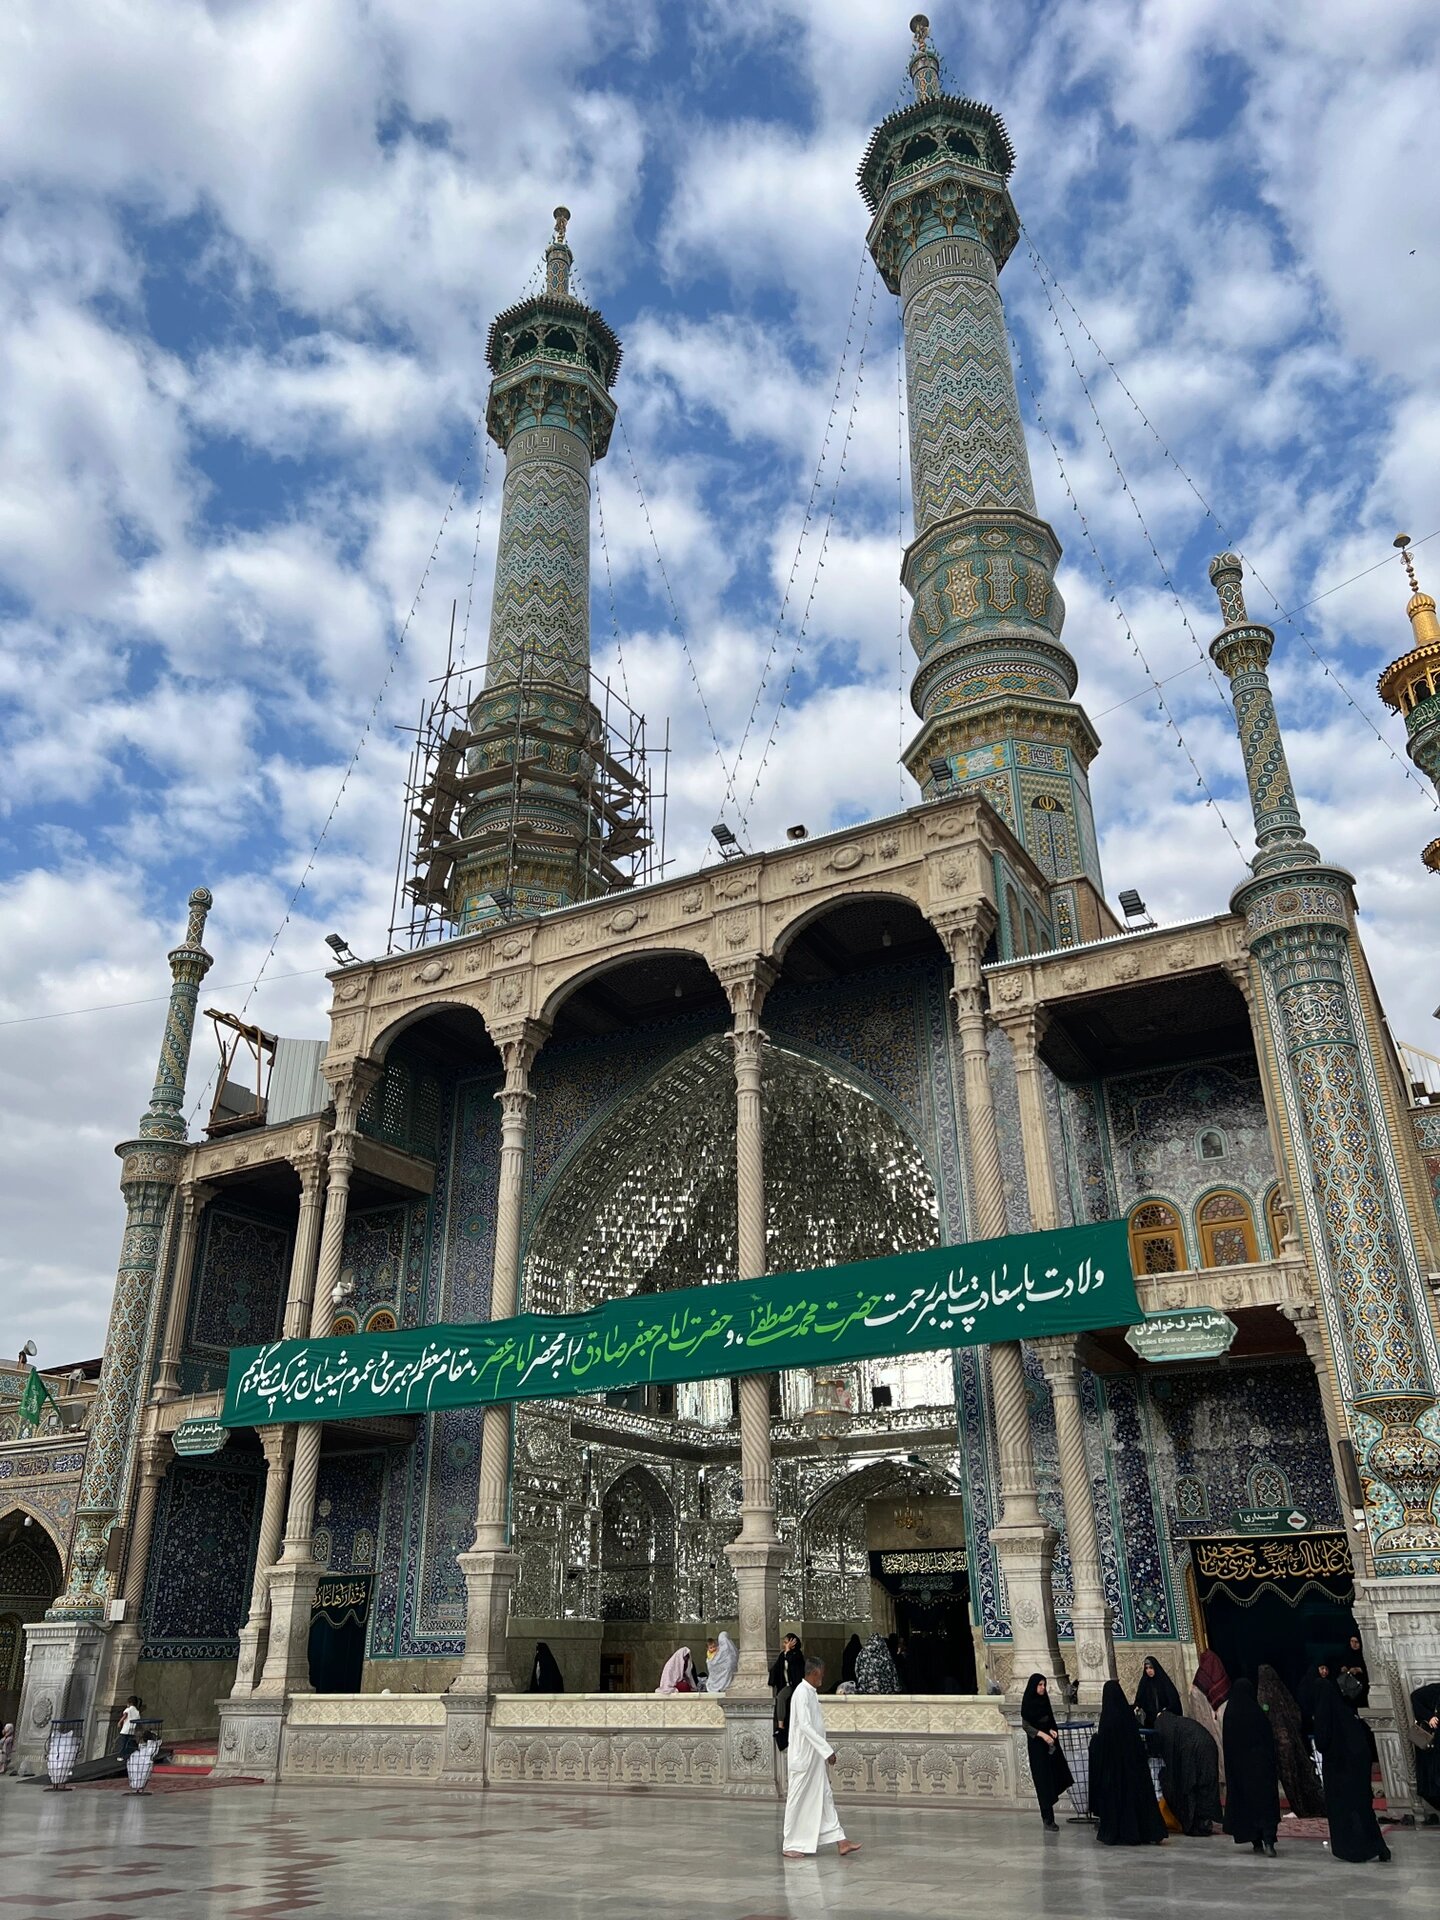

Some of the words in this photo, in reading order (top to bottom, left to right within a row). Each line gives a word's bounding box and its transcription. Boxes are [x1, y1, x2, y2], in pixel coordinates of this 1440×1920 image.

[906, 1267, 976, 1335] پیامبر
[1026, 1257, 1105, 1301] ولادت
[789, 1302, 819, 1338] محمد
[814, 1290, 883, 1343] حضرت
[864, 1282, 938, 1327] رحمت
[1135, 1318, 1175, 1335] خواهران
[1175, 1316, 1203, 1331] تشرف
[1203, 1315, 1226, 1329] محل
[572, 1325, 628, 1376] صادق
[617, 1320, 664, 1369] جعفر
[648, 1307, 690, 1382] امام
[668, 1308, 734, 1358] حضرت
[1158, 1336, 1185, 1344] Entrance
[294, 1350, 347, 1404] شیعیان
[337, 1359, 376, 1407] عموم
[371, 1359, 420, 1397] رهبری
[406, 1342, 451, 1410] معظم
[427, 1347, 473, 1410] مقام
[493, 1333, 535, 1400] امام
[517, 1332, 566, 1387] محضر
[1243, 1511, 1279, 1523] کفشداری
